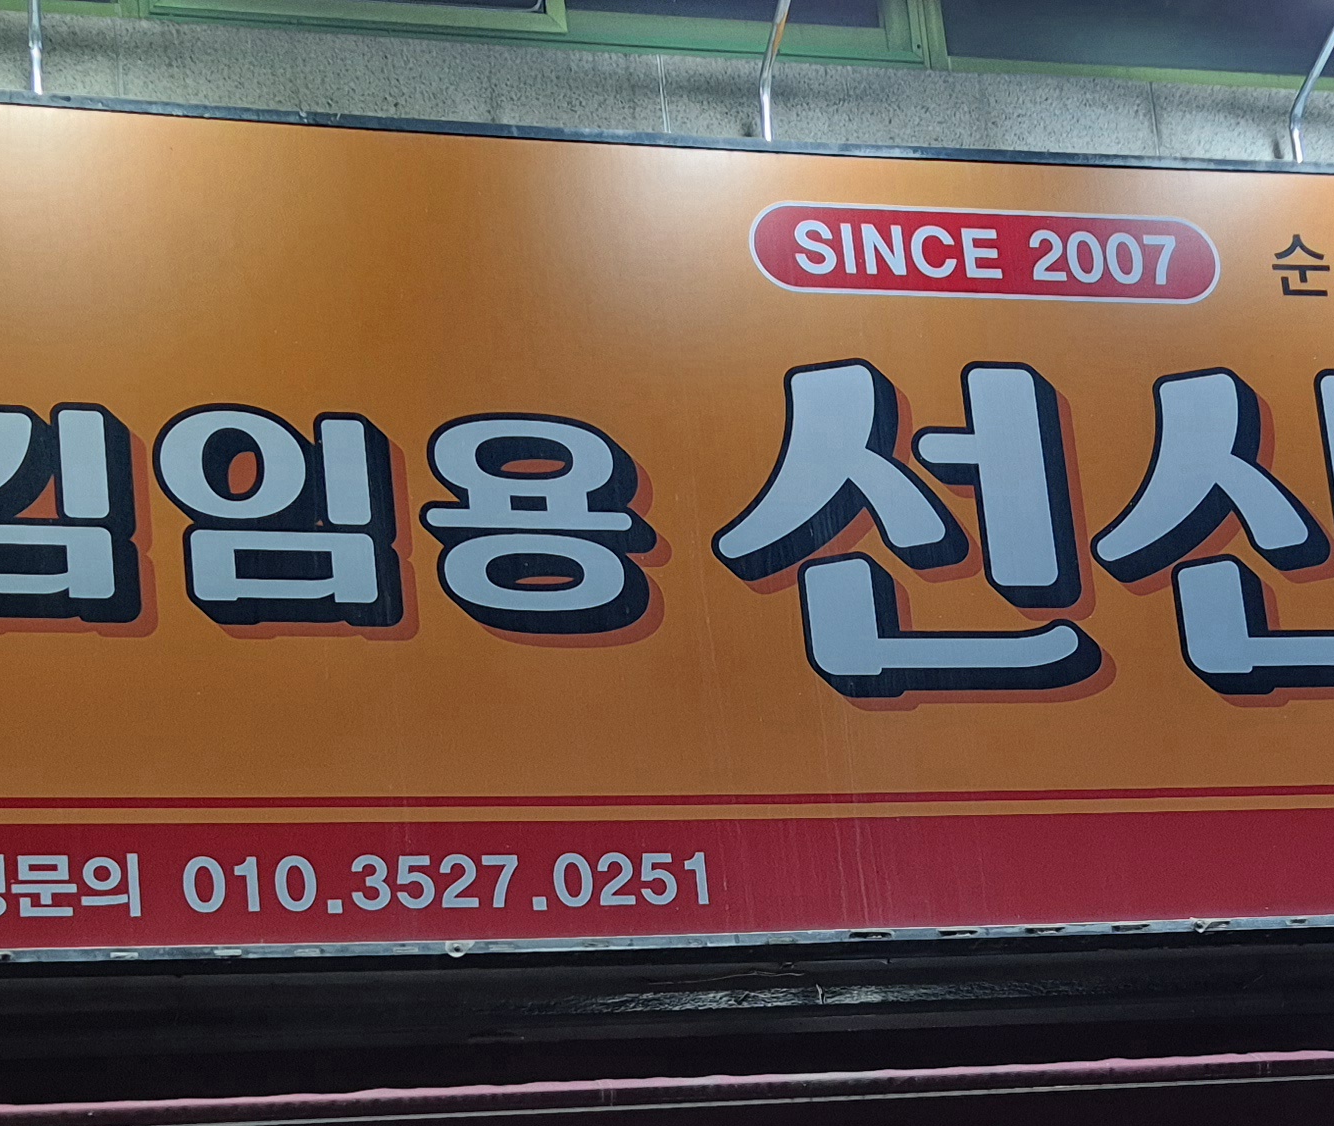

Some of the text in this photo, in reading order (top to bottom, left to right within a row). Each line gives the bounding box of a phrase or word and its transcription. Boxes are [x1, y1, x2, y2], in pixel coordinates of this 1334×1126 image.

[794, 220, 1177, 286] SINCE 2007
[182, 850, 712, 915] 010.3527.0251
